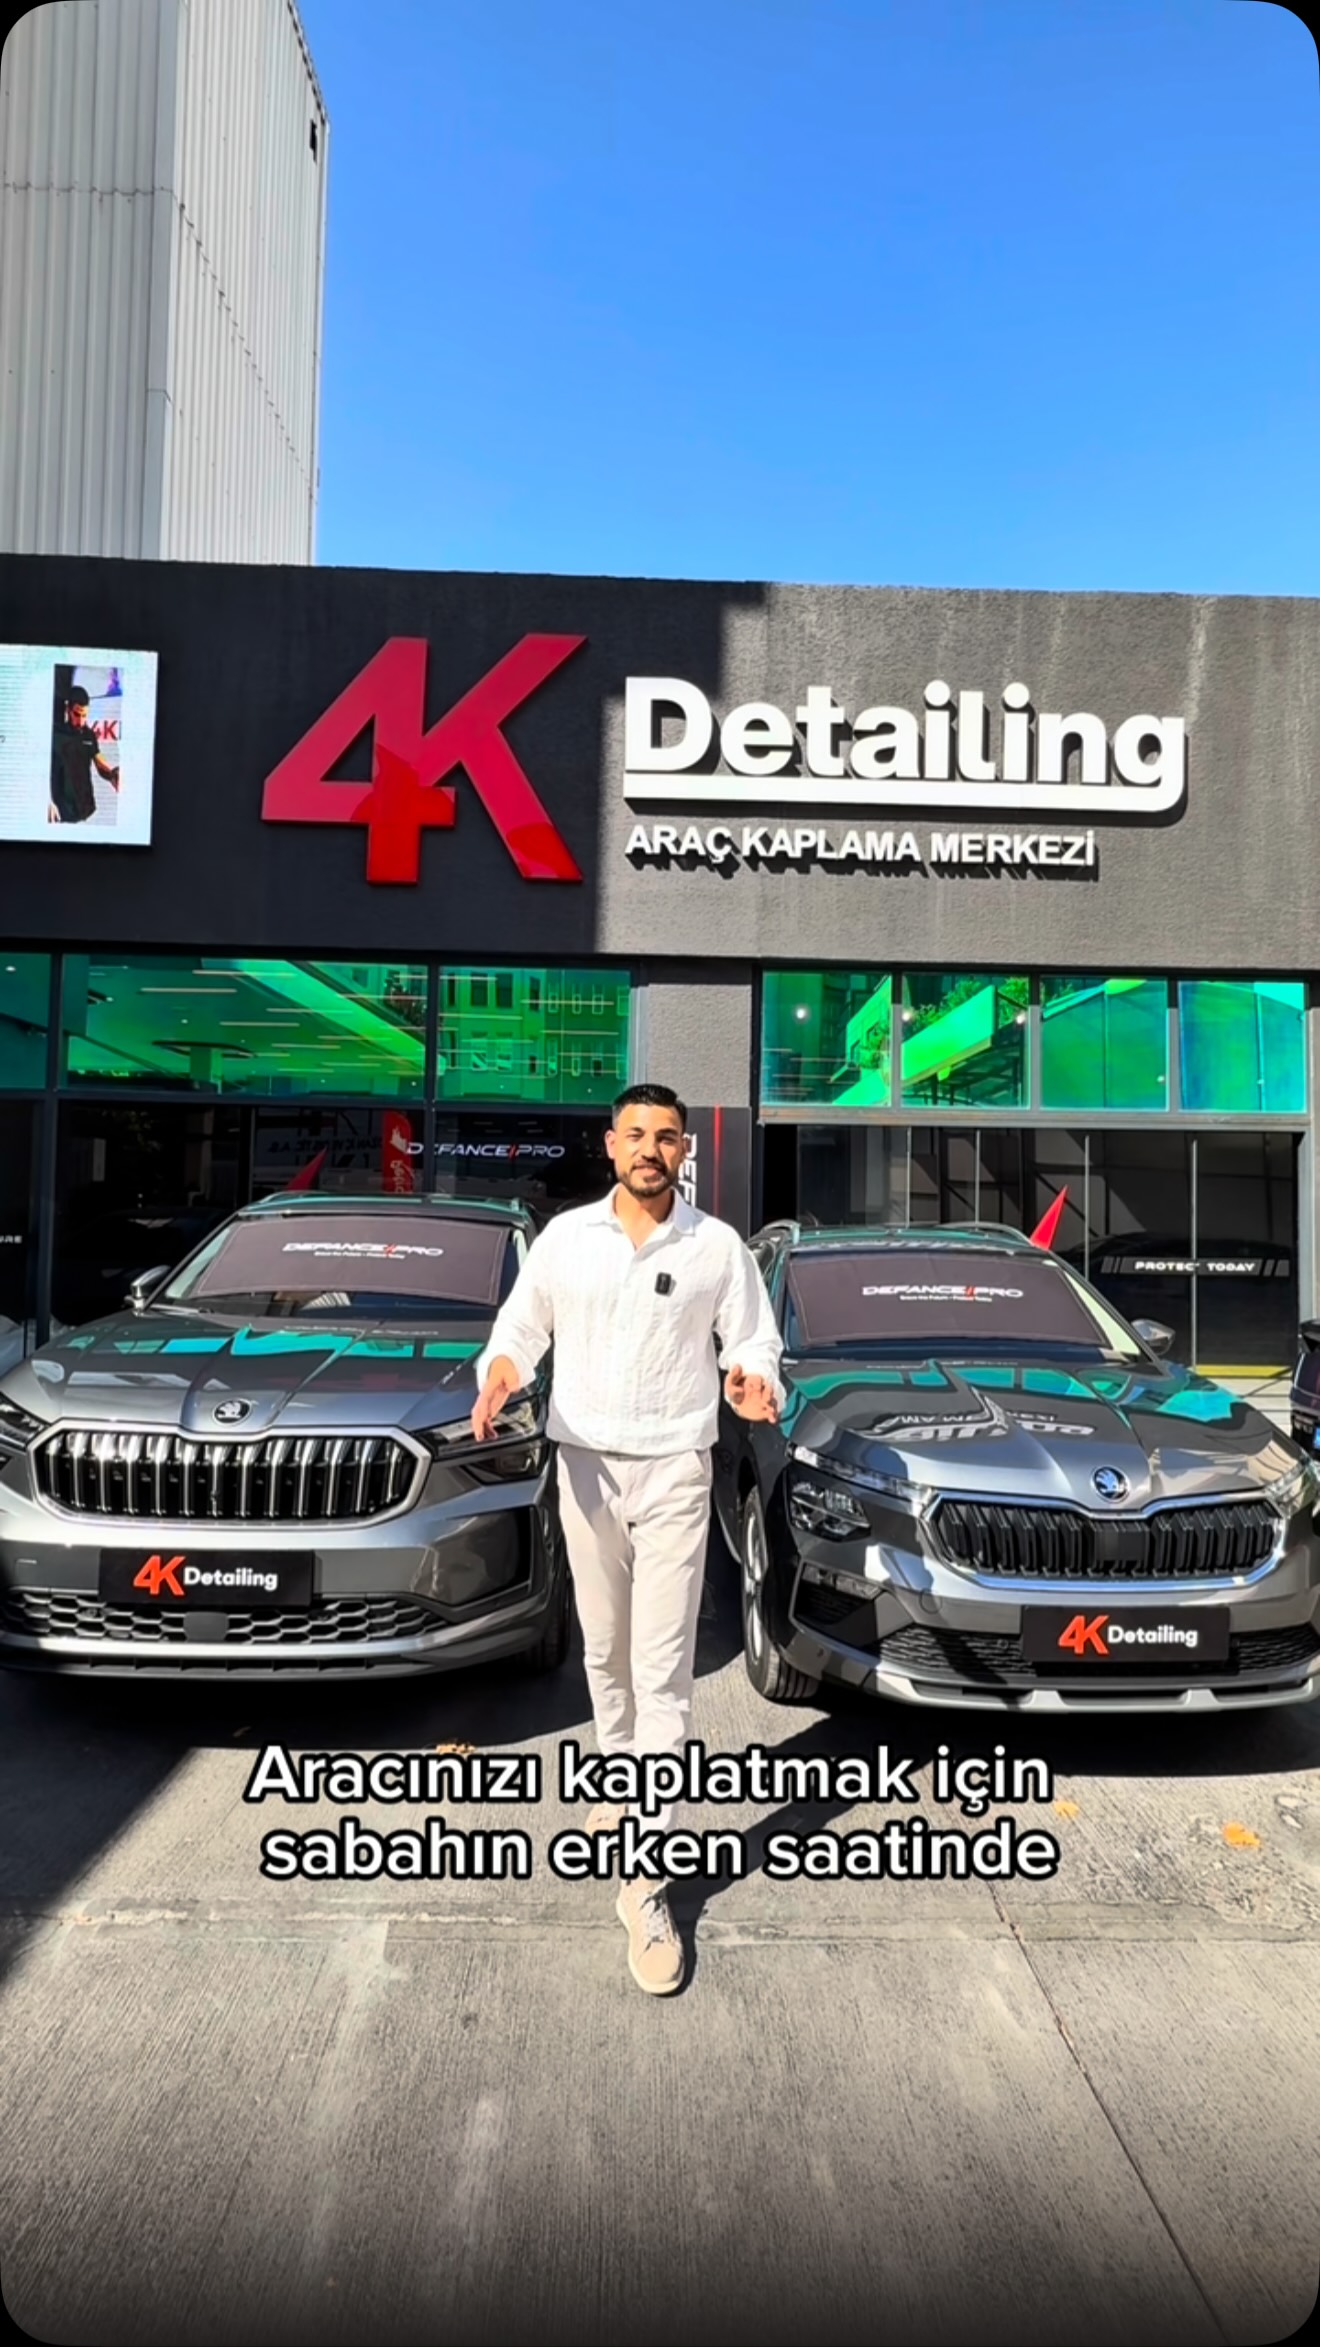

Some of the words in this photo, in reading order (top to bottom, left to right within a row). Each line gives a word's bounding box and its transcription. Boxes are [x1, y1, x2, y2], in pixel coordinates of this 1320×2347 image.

[261, 633, 588, 885] 4K
[624, 676, 1186, 812] Detailing
[624, 825, 731, 863] ARAÇ
[741, 827, 922, 862] KAPLAMA
[930, 829, 1095, 867] MERKEZİ
[1207, 1262, 1255, 1272] TODAY
[133, 1555, 186, 1595] 4K
[184, 1567, 278, 1592] Detailing
[1058, 1615, 1109, 1654] 4K
[1108, 1625, 1198, 1648] Detailing
